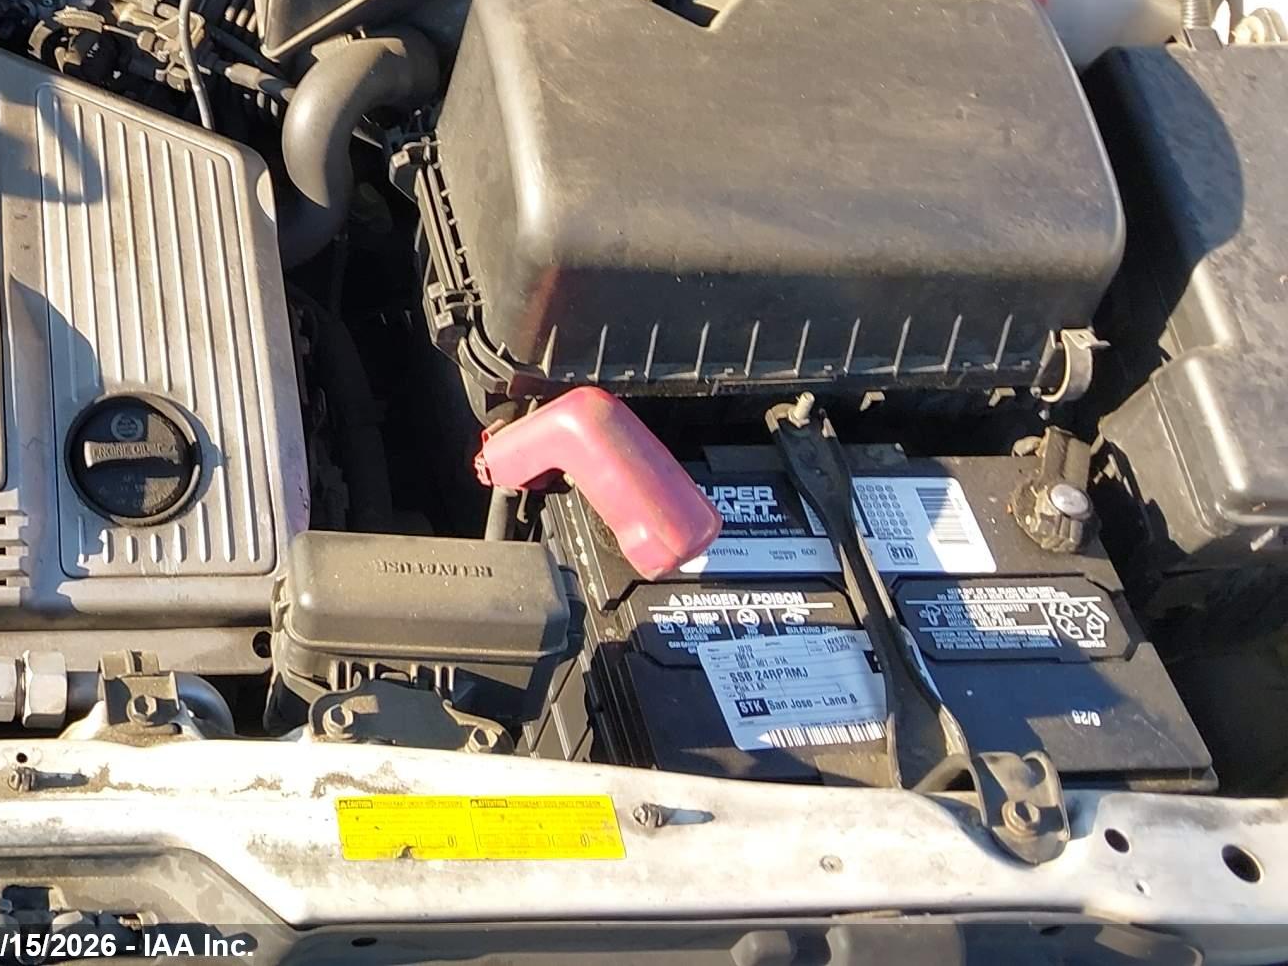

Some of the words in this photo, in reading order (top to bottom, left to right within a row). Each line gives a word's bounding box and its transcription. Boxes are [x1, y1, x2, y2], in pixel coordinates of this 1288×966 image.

[697, 485, 774, 500] UPER
[713, 501, 778, 516] ART
[890, 546, 915, 559] STD
[681, 594, 742, 607] DANGER
[752, 592, 806, 605] POISON
[756, 667, 810, 681] 24RPRMJ
[740, 701, 764, 714] STK
[768, 700, 788, 711] San
[791, 698, 813, 709] Jose
[823, 695, 848, 707] Lane
